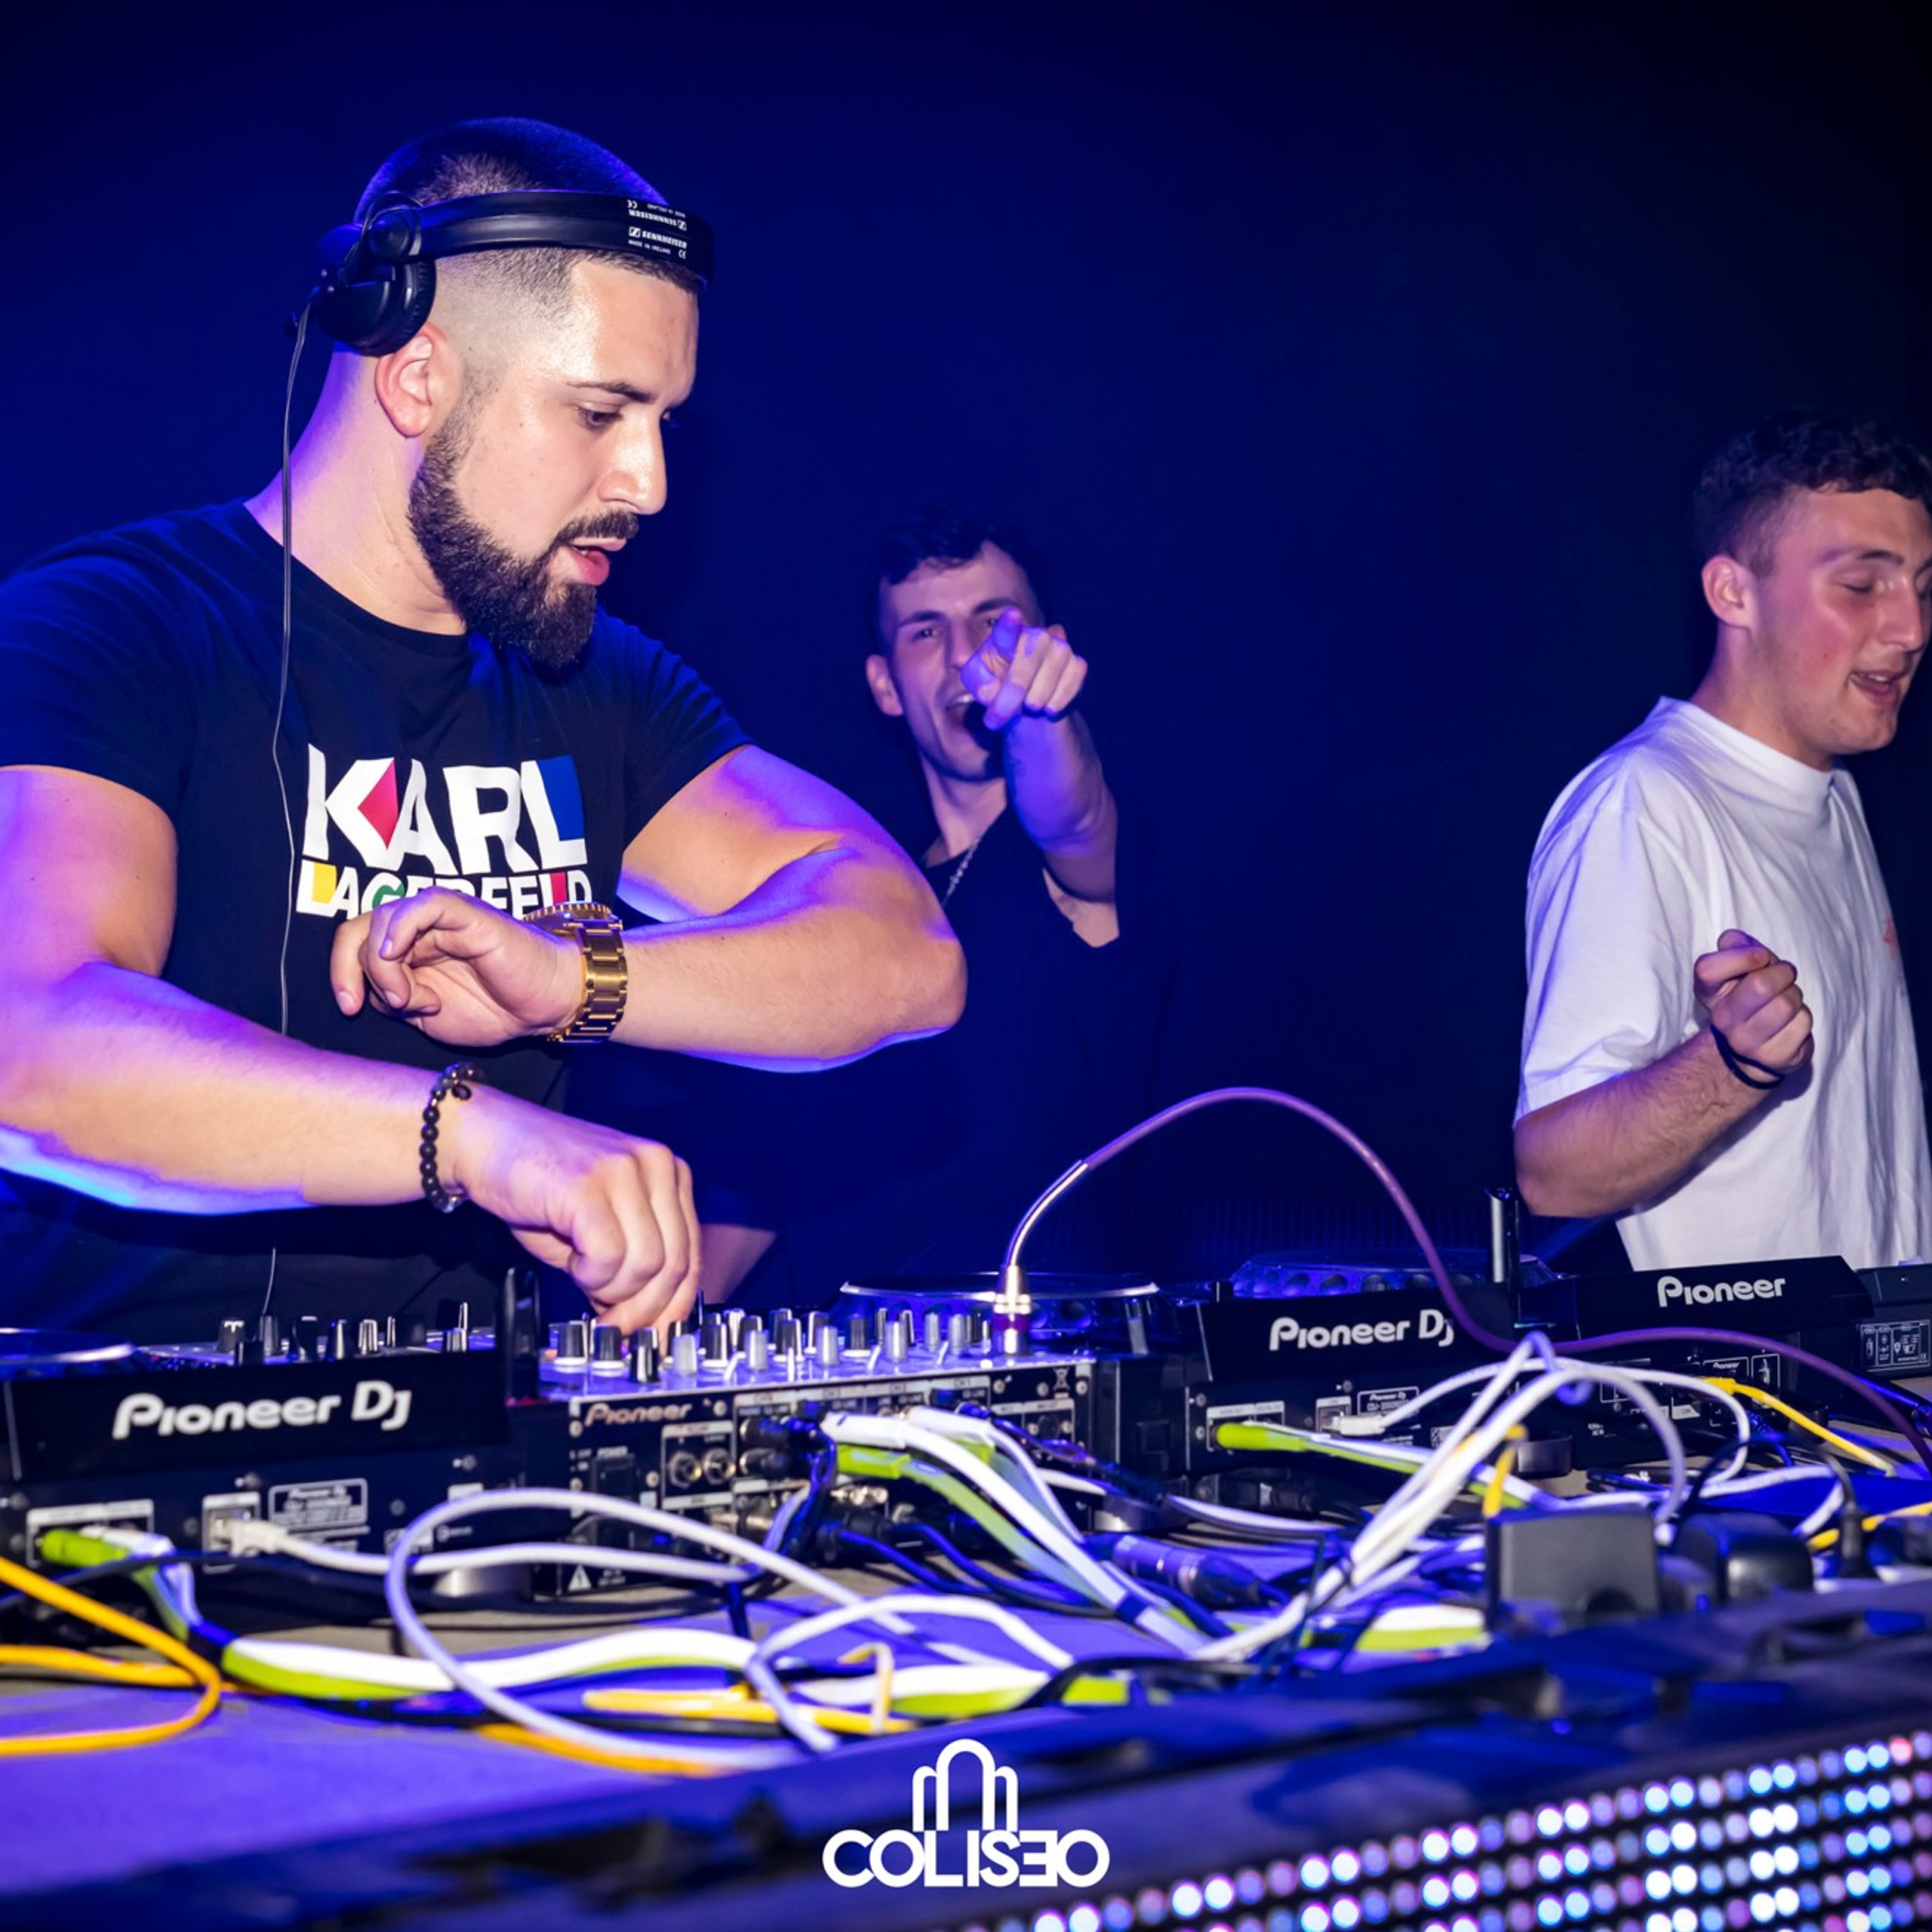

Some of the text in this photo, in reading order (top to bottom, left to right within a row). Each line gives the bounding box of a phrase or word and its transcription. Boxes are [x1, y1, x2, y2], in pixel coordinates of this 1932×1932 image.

[642, 230, 687, 249] SENNHEISER
[302, 743, 588, 875] KARL
[1657, 1275, 1786, 1307] Pioneer
[1269, 1317, 1410, 1351] Pioneer
[112, 1393, 341, 1439] Pioneer
[584, 1402, 692, 1426] Pioneer
